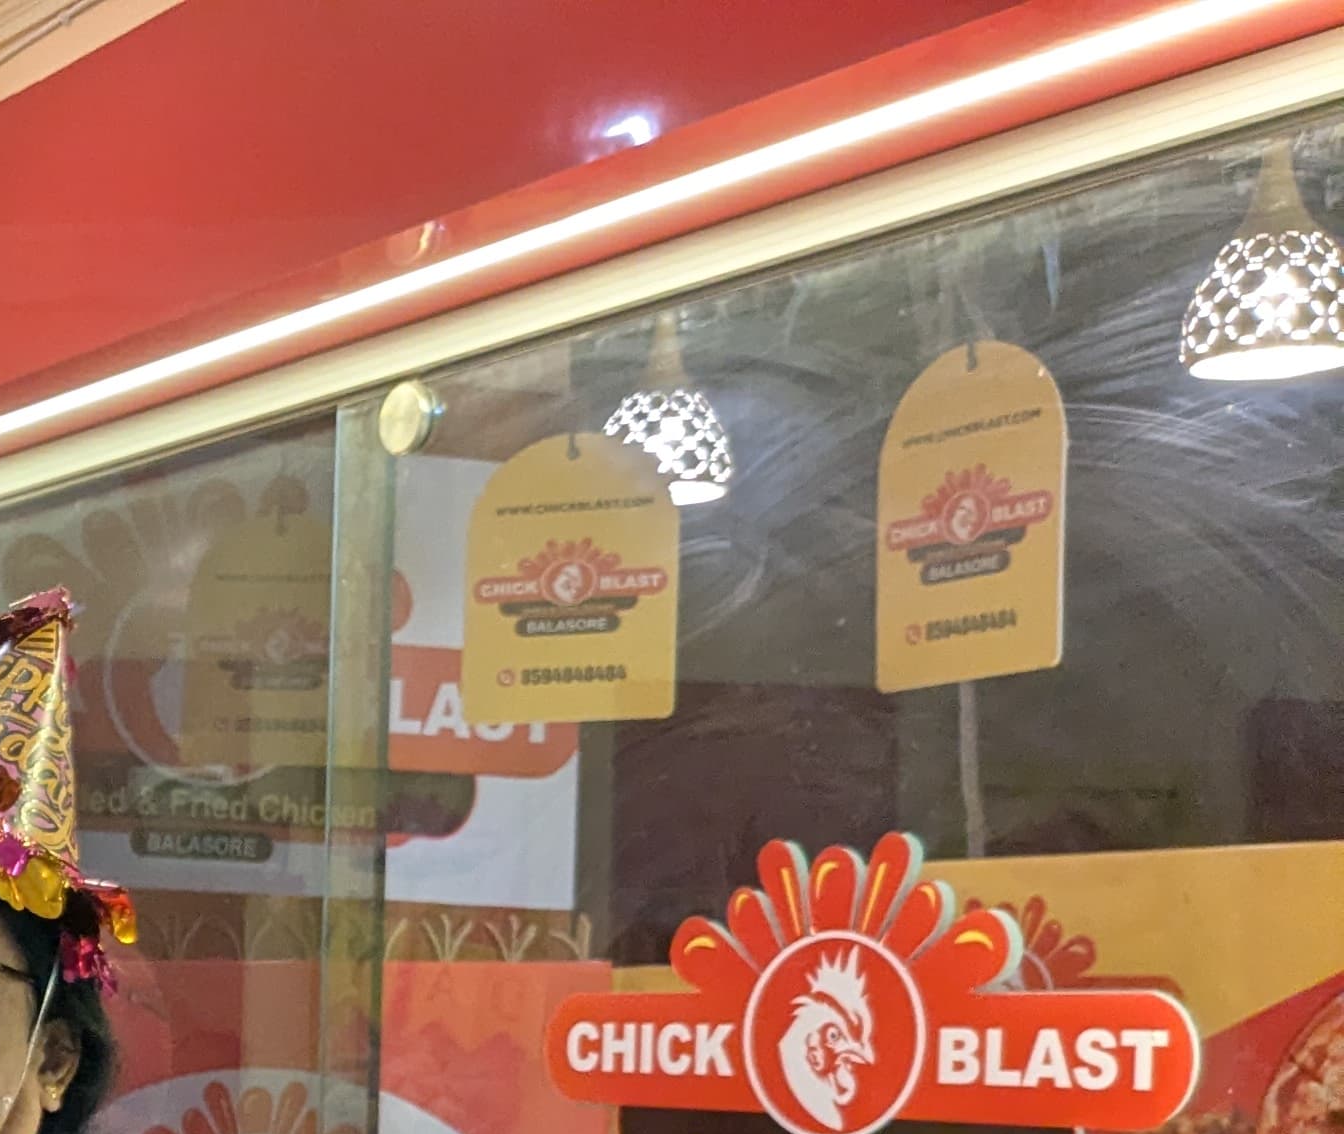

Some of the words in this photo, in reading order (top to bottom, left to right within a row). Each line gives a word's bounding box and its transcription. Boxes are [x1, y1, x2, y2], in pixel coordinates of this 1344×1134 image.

[990, 499, 1047, 523] BLAST
[480, 582, 539, 599] CHICK
[600, 573, 663, 590] BLAST
[526, 617, 608, 634] BALASORE
[146, 833, 257, 859] BALASORE
[565, 1020, 736, 1077] CHICK
[936, 1027, 1170, 1092] BLAST
